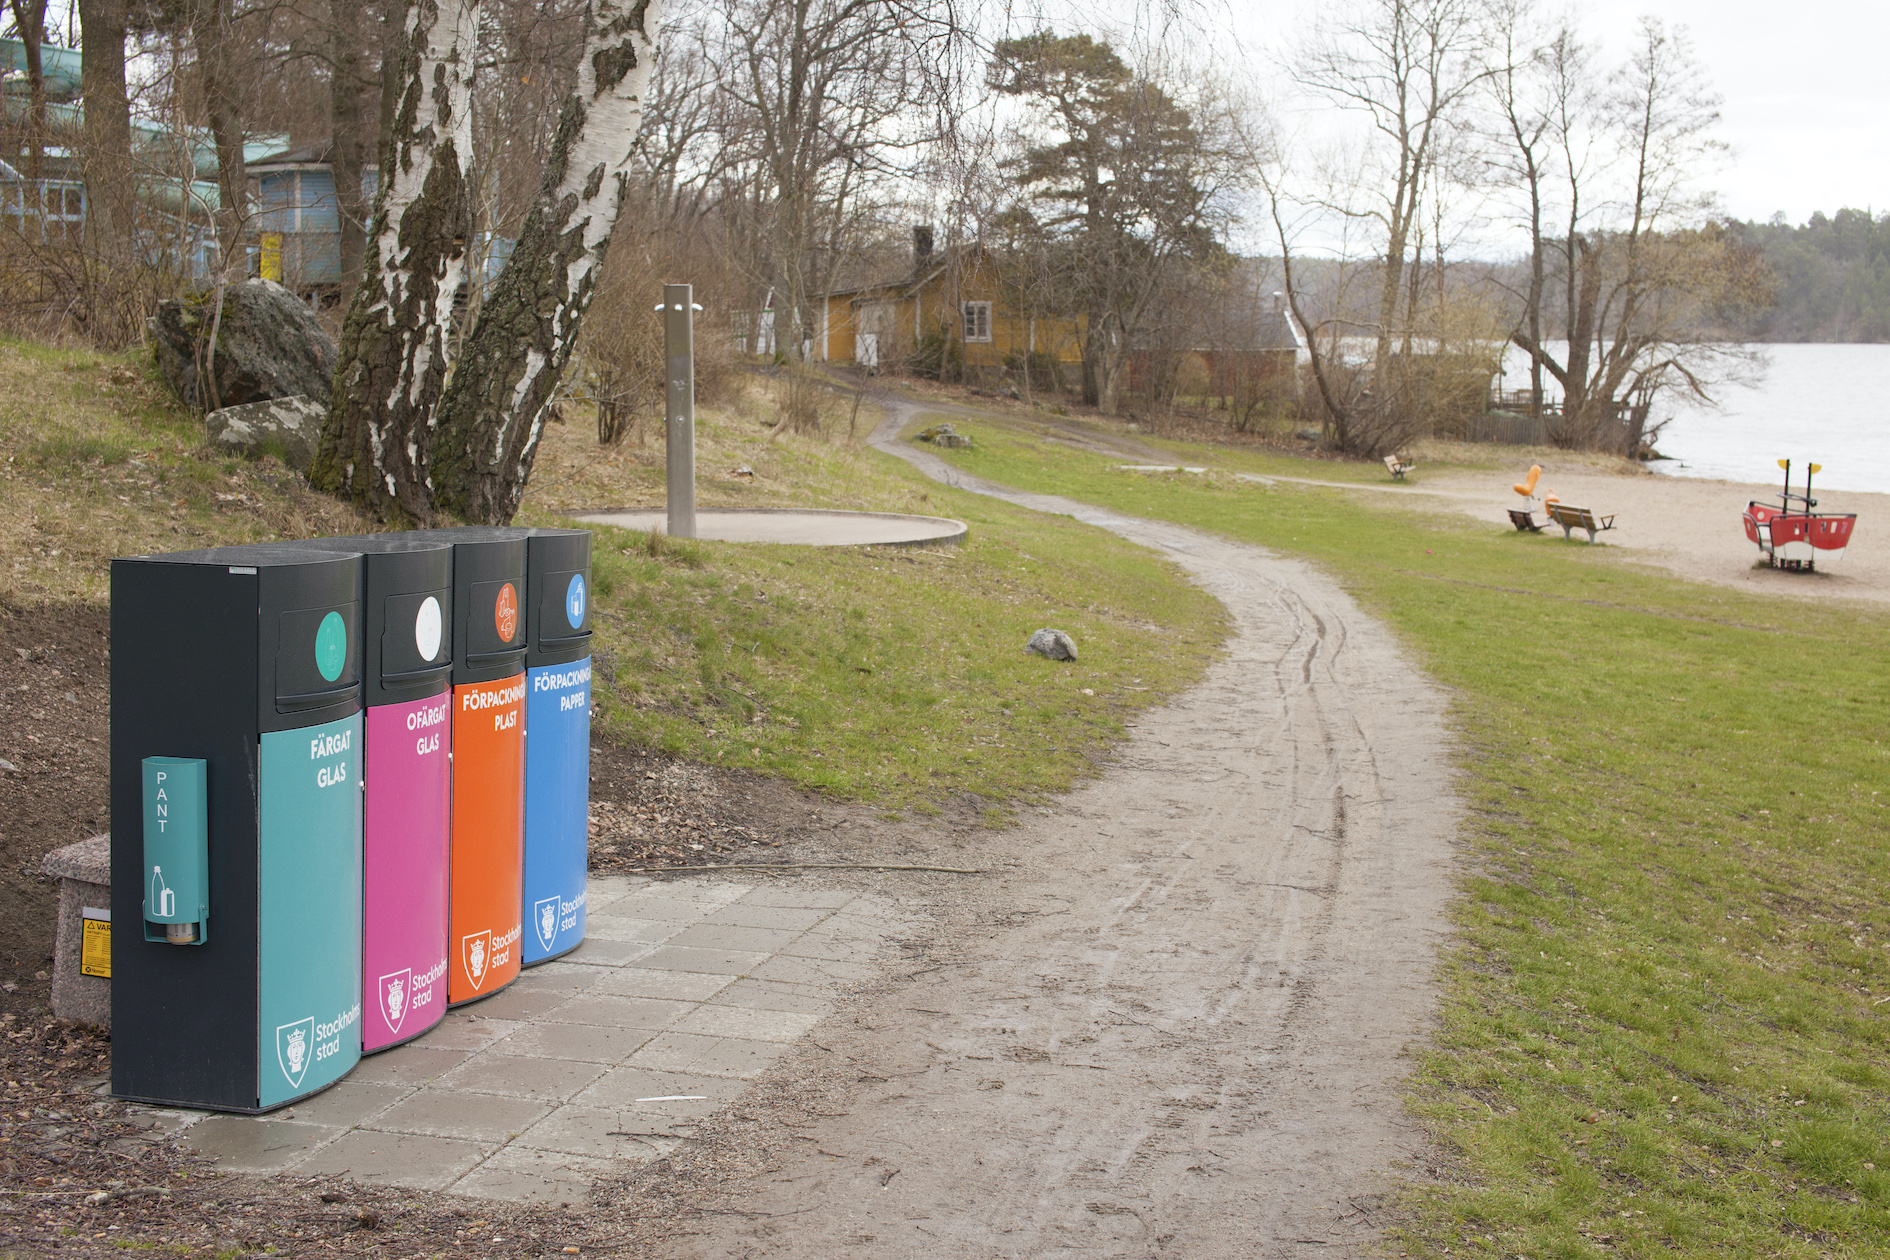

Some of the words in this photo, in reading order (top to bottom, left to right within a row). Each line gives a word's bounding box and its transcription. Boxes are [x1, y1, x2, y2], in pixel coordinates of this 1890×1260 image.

[560, 691, 585, 711] PAPPER
[406, 704, 446, 730] OFÄRGAT
[494, 710, 518, 731] PLAST
[310, 729, 352, 760] FÄRGAT
[416, 733, 439, 756] GLAS
[317, 762, 346, 788] GLAS
[156, 771, 168, 833] PANT
[561, 911, 577, 932] stad
[491, 946, 509, 969] stad
[412, 984, 432, 1010] stad
[316, 1003, 361, 1042] Stockholms
[316, 1033, 340, 1062] stad
